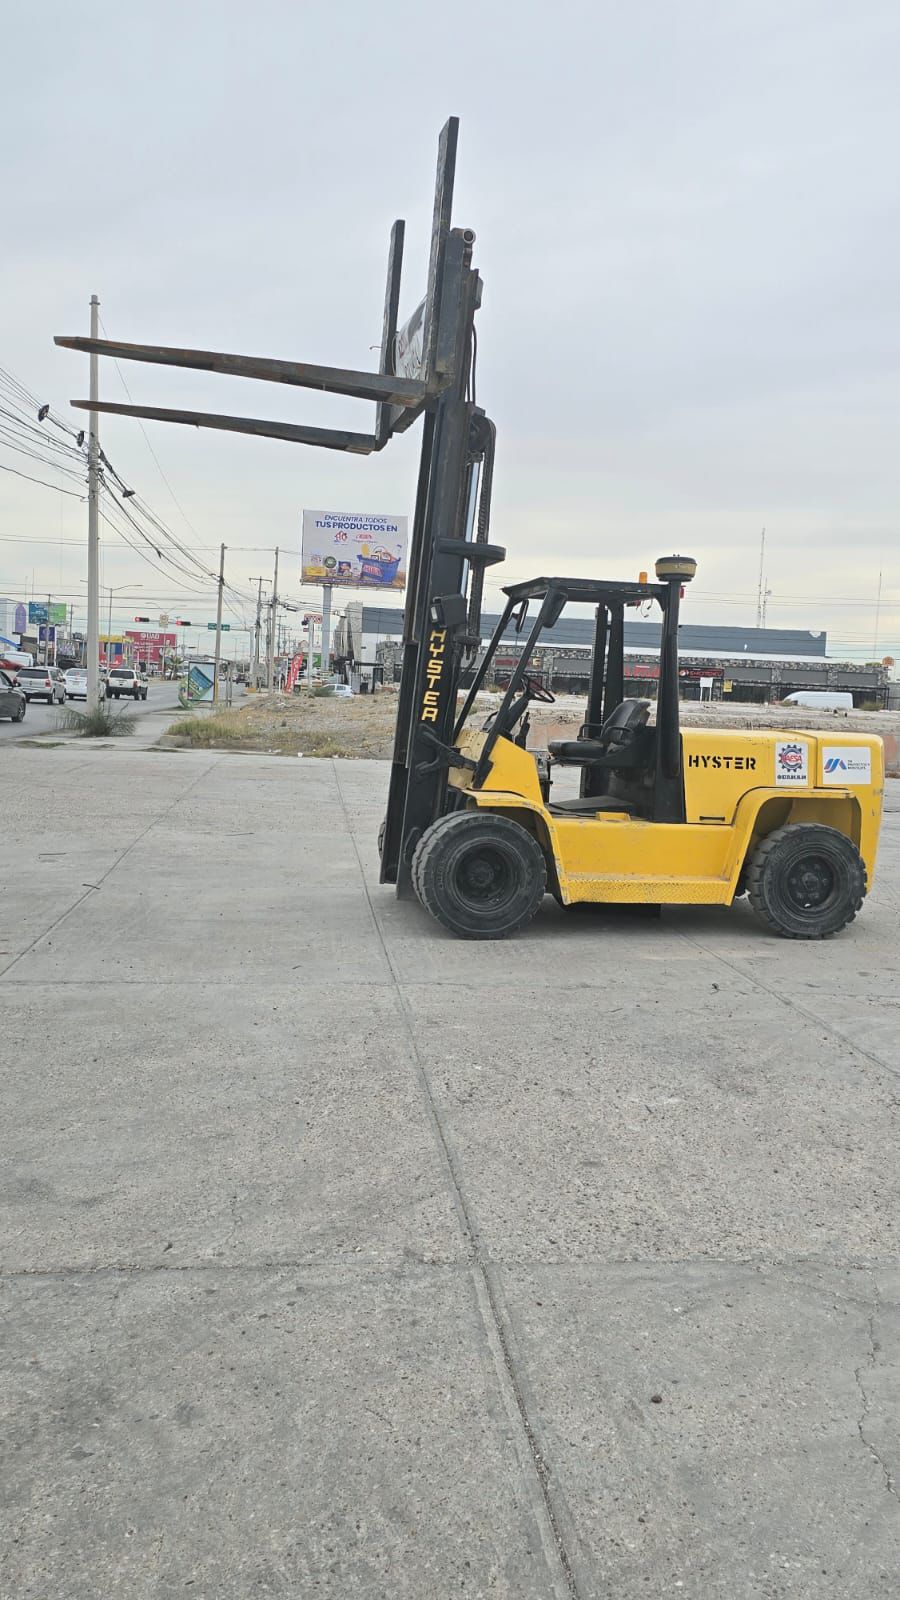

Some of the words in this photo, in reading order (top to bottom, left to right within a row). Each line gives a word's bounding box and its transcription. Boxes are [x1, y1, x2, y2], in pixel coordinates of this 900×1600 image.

[324, 514, 363, 523] ENCUENTRA
[315, 520, 332, 528] TUS
[332, 522, 385, 532] PRODUCTOS
[421, 629, 447, 722] HYSTER
[688, 754, 756, 770] HYSTER
